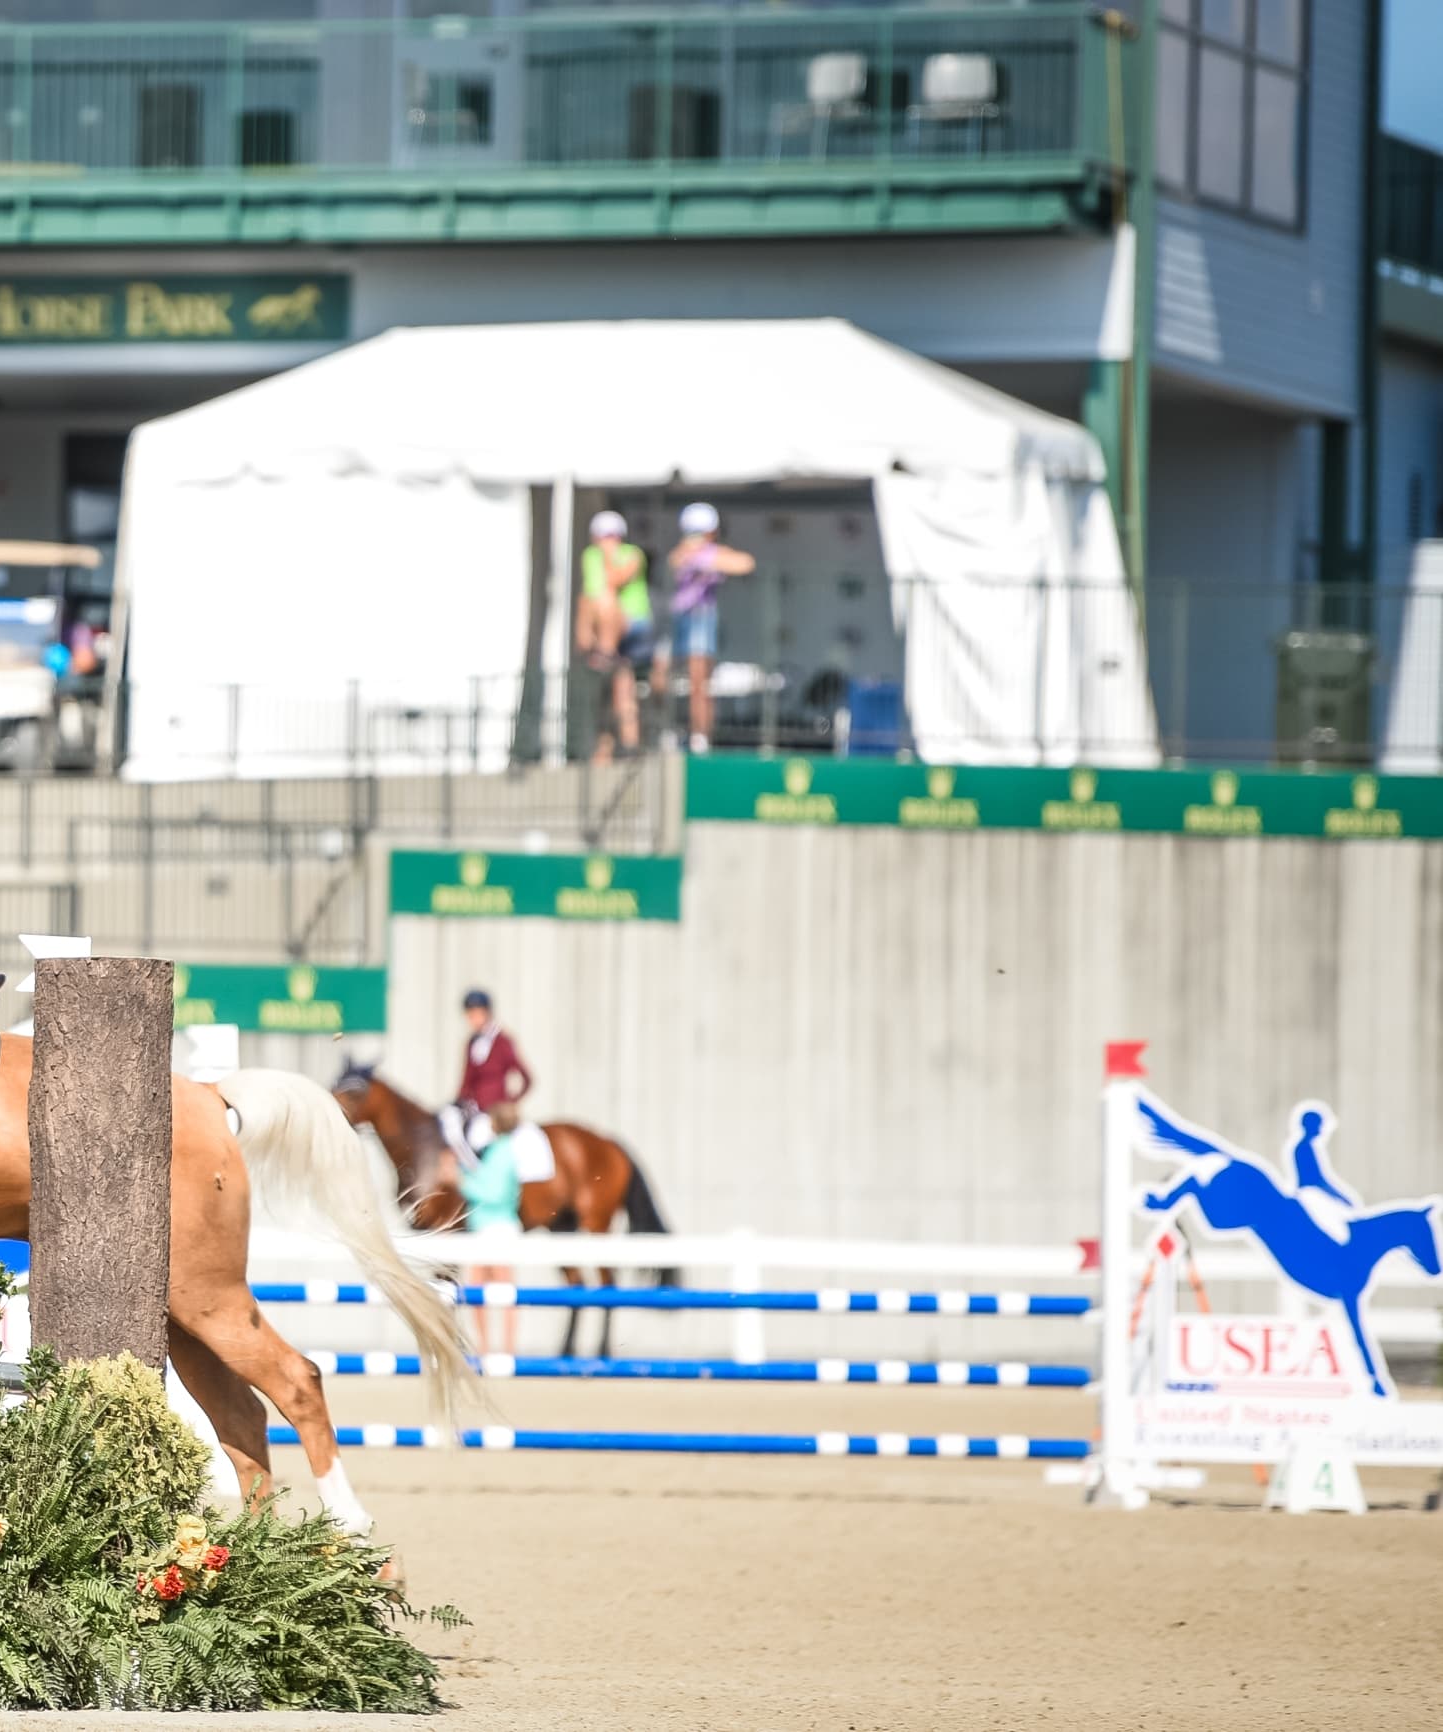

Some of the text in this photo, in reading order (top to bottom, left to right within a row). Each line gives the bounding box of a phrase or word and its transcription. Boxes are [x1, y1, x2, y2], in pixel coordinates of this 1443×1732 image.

[124, 282, 234, 338] PARK
[1175, 1324, 1342, 1377] USEA
[1312, 1461, 1335, 1499] 4
